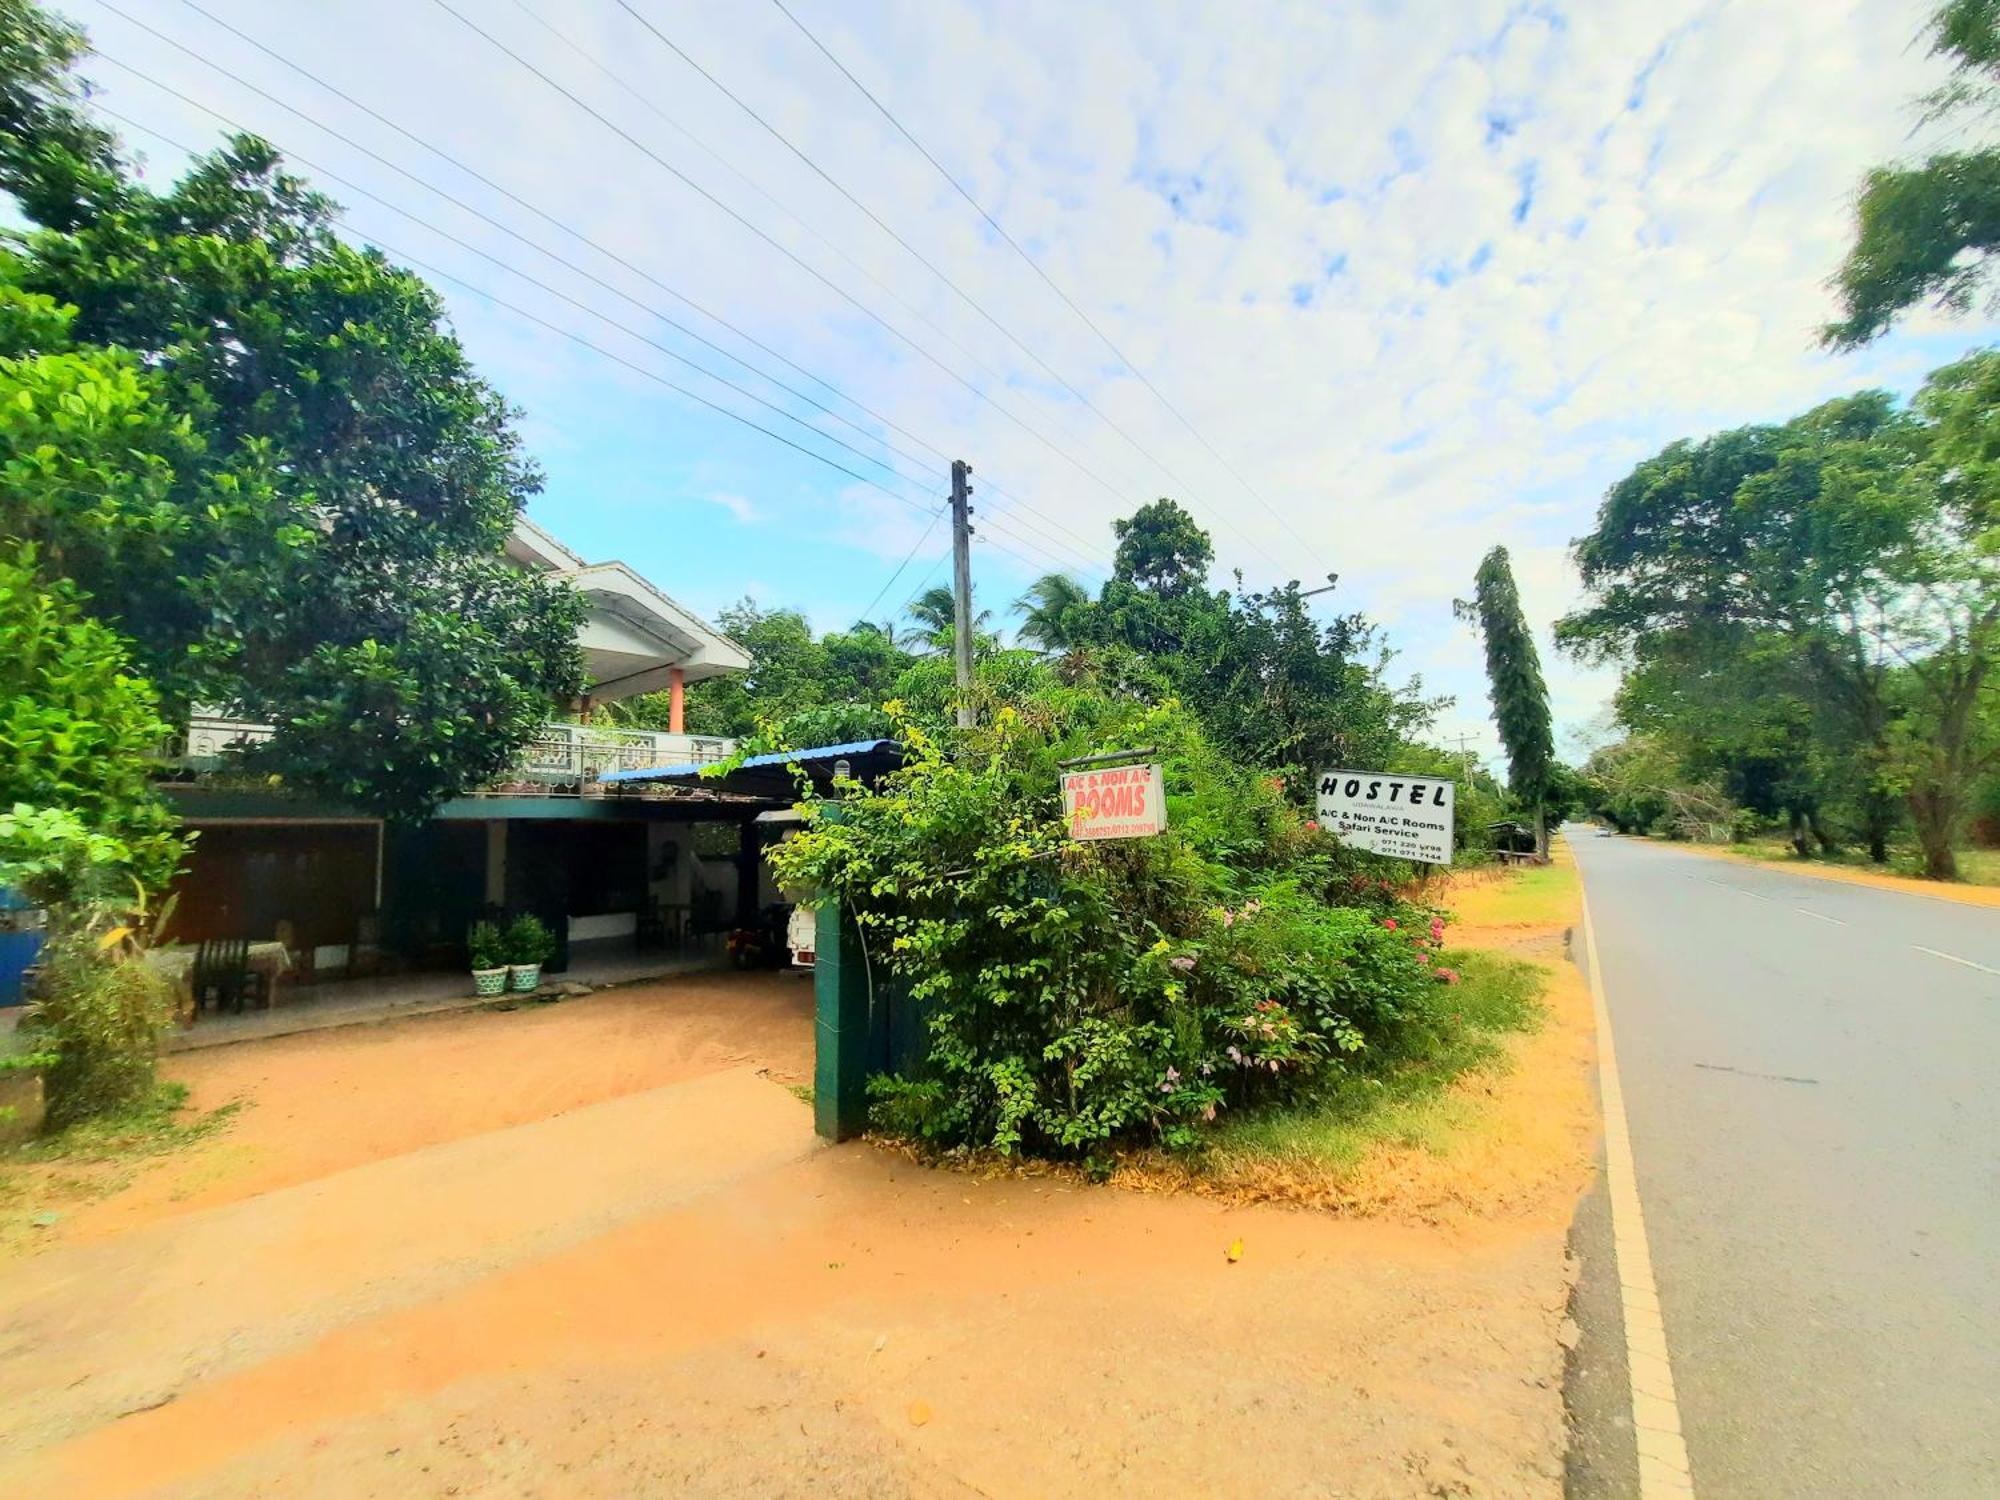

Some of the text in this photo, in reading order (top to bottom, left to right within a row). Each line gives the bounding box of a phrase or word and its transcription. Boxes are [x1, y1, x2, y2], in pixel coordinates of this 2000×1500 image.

[1088, 775, 1098, 788] &
[1101, 770, 1128, 786] NON
[1320, 777, 1445, 807] HOSTEL
[1320, 809, 1338, 818] A/C
[1353, 813, 1376, 823] Non
[1379, 816, 1399, 825] A/C
[1402, 818, 1445, 831] Rooms
[1338, 821, 1420, 838] Safari Service
